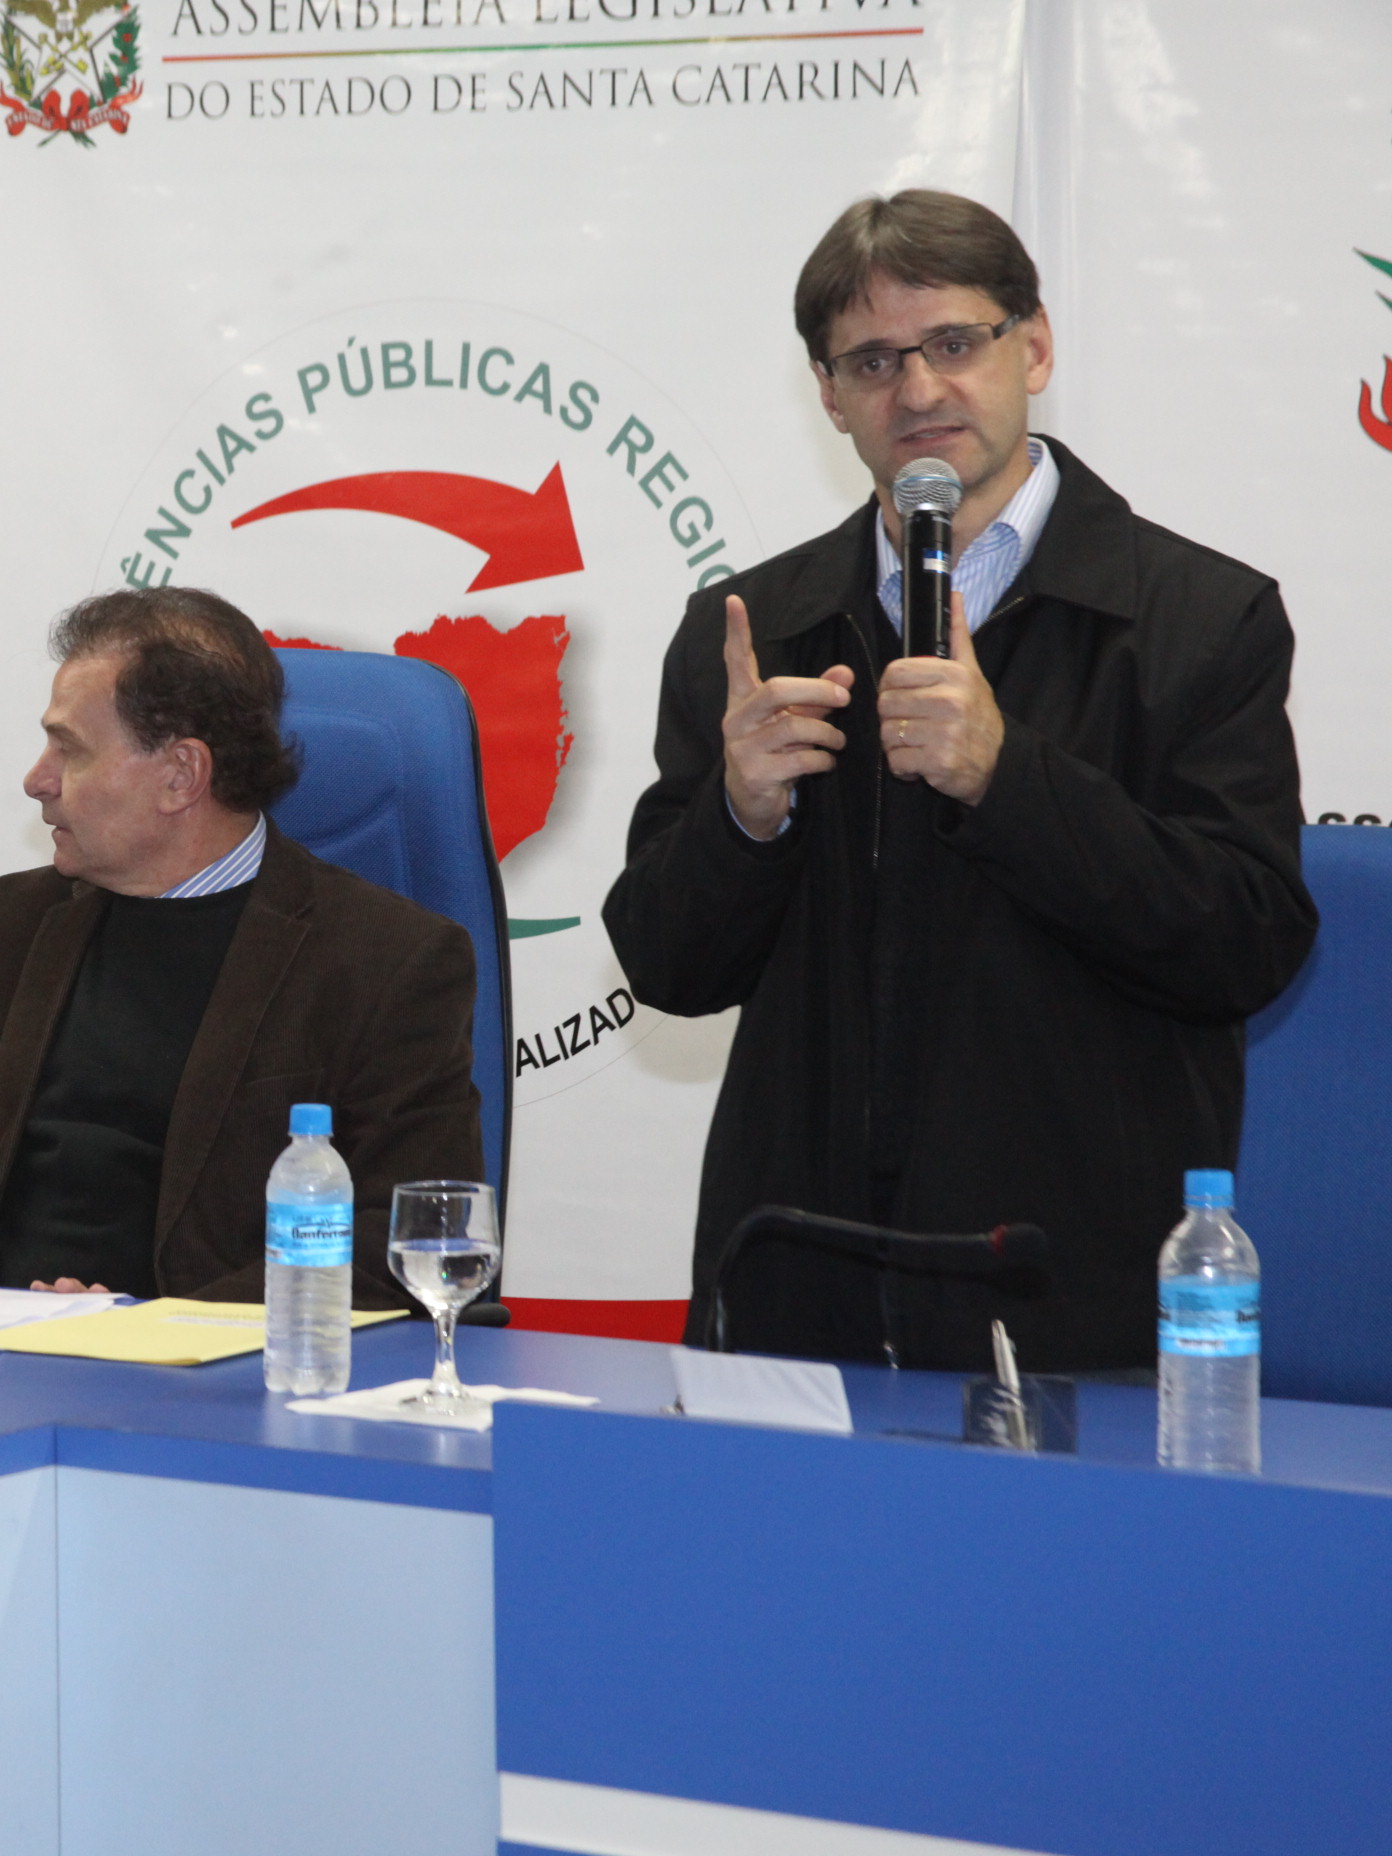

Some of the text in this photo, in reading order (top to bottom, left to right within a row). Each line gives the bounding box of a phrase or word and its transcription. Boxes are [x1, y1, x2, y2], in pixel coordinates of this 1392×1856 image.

[166, 81, 230, 120] DO
[249, 74, 413, 119] ESTADO
[432, 72, 488, 114] DE
[506, 66, 656, 113] SANTA
[672, 57, 920, 107] CATARINA
[295, 336, 600, 432] PÚBLICAS
